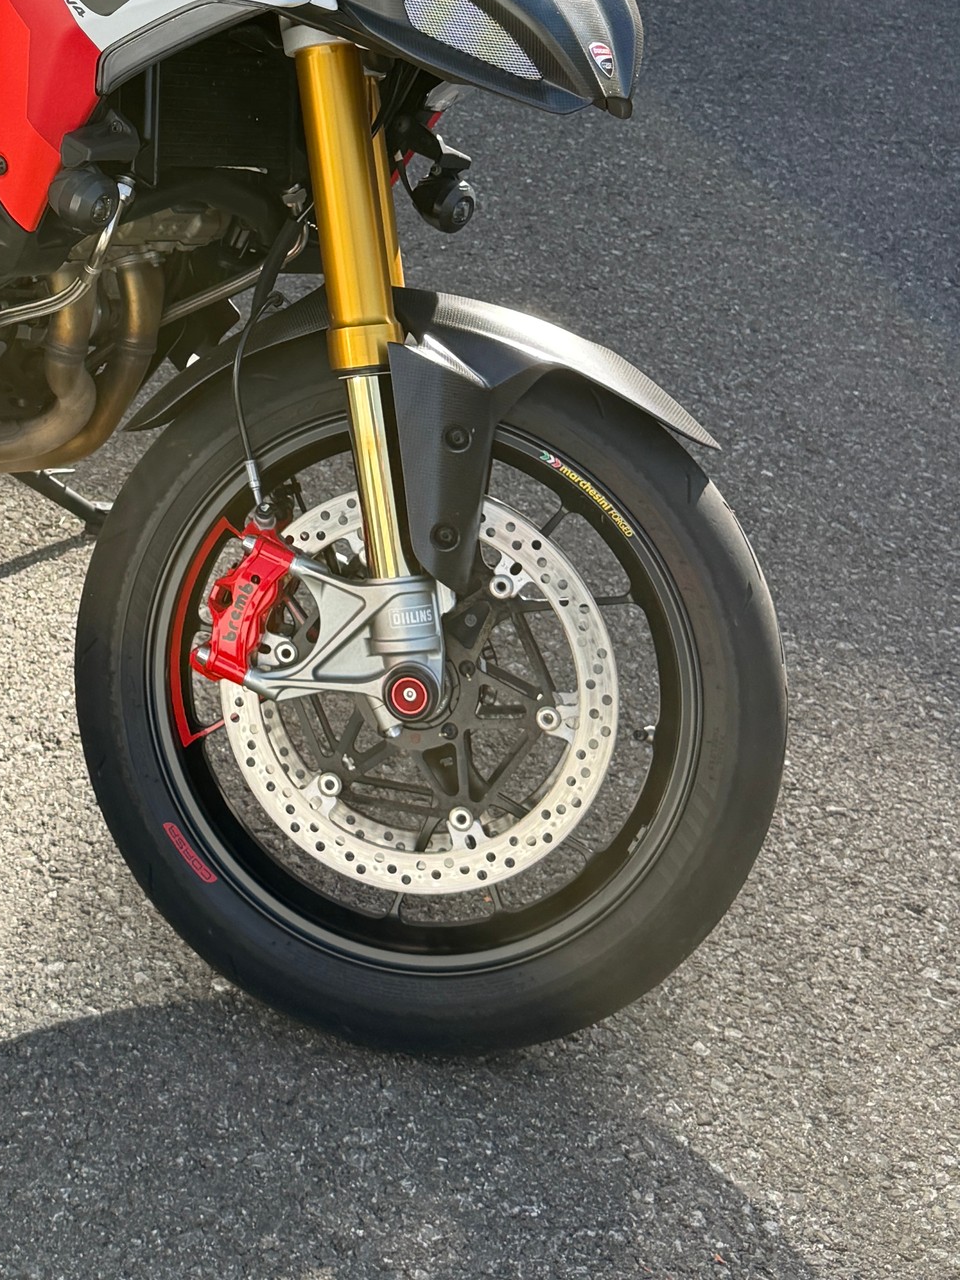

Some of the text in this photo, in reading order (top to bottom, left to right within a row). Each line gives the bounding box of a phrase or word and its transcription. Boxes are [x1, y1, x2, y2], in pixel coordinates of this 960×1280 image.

[559, 465, 634, 538] marchesini FORGED
[167, 824, 213, 880] CORSA
